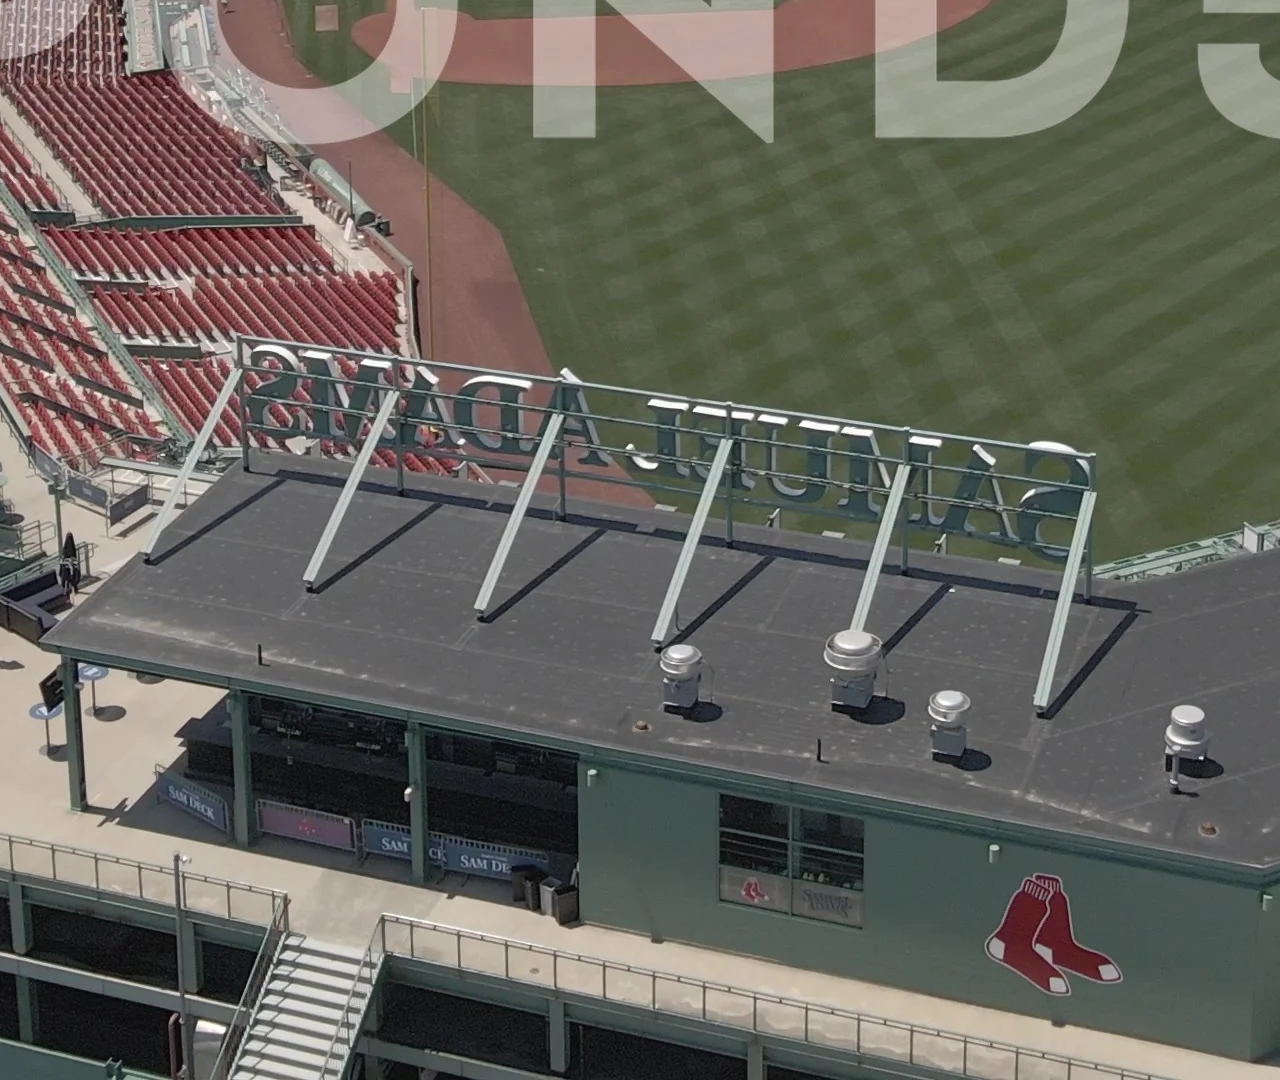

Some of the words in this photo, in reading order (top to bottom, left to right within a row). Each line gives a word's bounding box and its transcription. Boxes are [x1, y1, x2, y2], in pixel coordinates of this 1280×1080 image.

[188, 796, 215, 820] DECK
[381, 837, 408, 853] SAM
[460, 855, 488, 871] SAM
